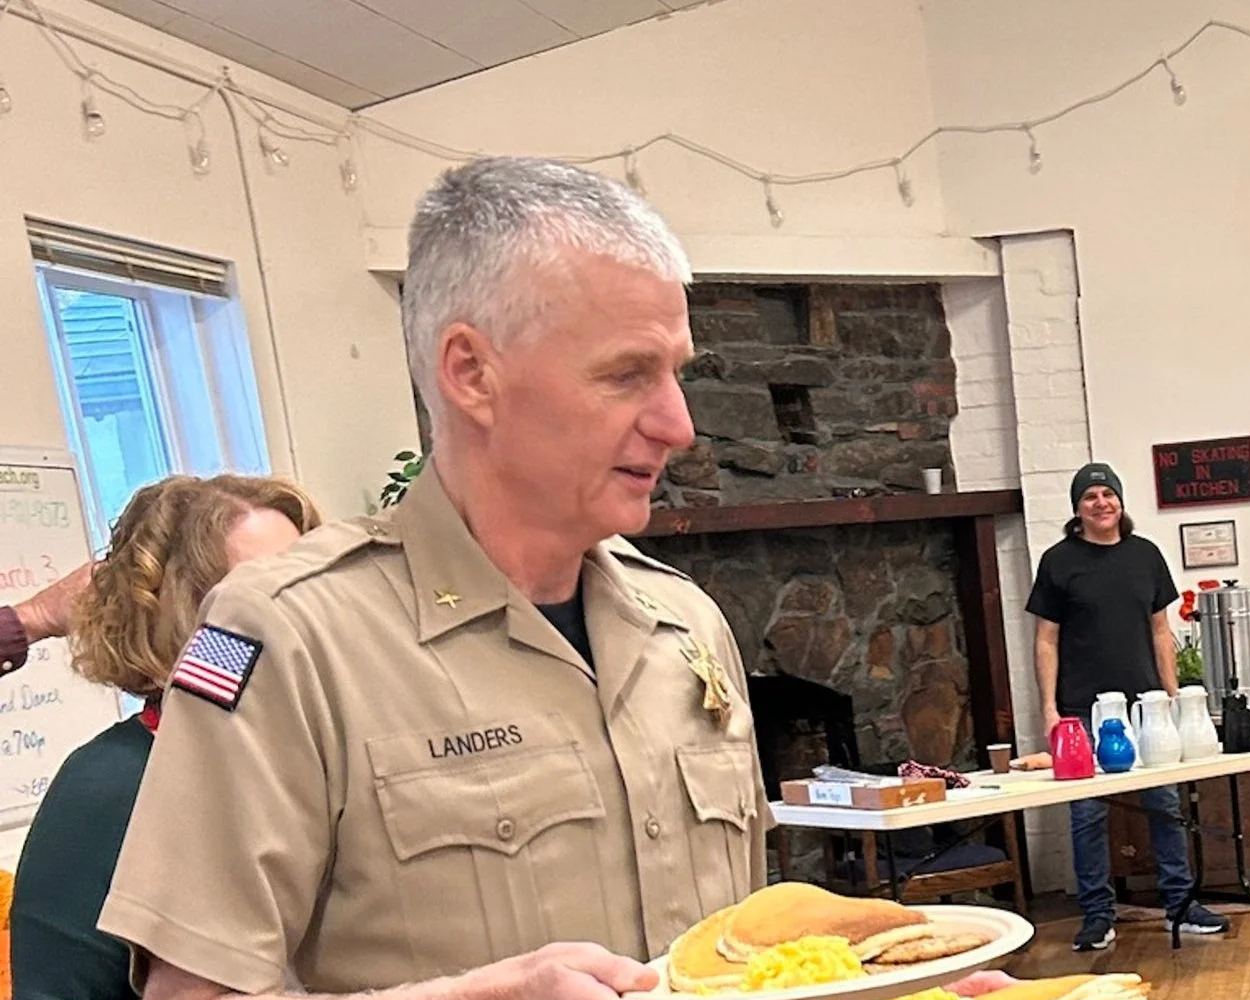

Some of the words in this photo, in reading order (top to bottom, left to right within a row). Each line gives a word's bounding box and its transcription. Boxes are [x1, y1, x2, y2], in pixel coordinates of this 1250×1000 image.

[1159, 451, 1178, 468] NO
[1191, 445, 1249, 463] SKATING
[1195, 464, 1211, 480] IN
[1175, 480, 1239, 498] KITCHEN
[427, 724, 524, 759] LANDERS
